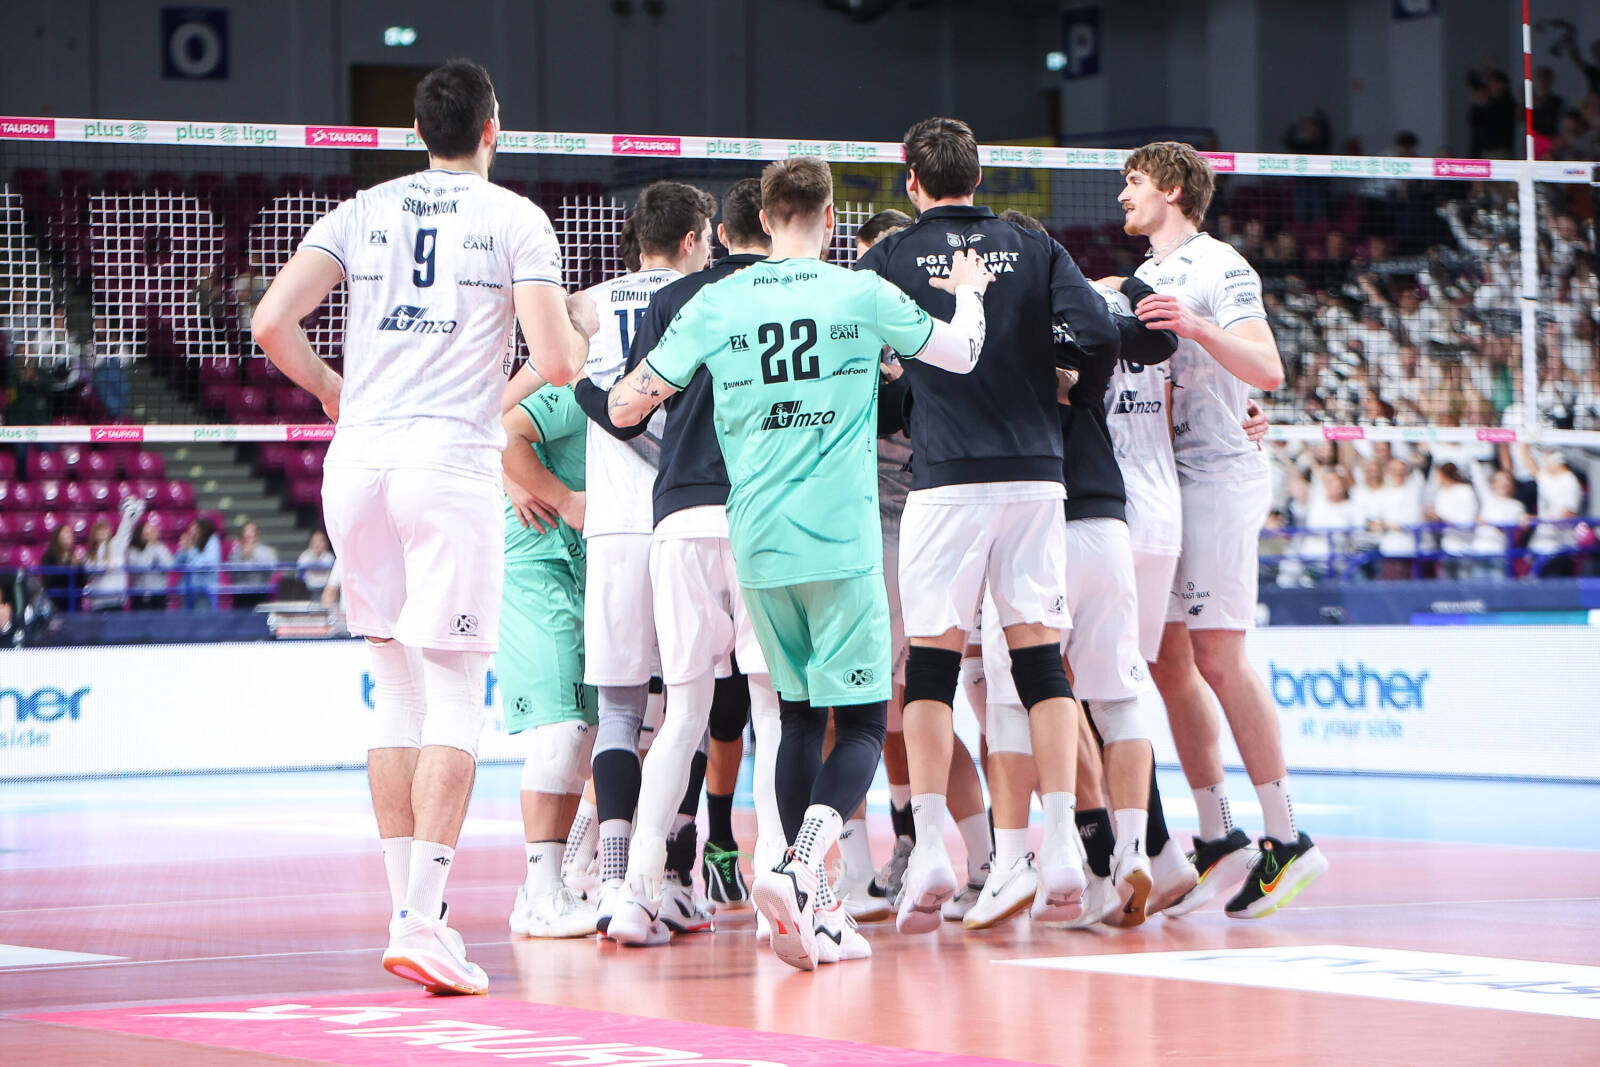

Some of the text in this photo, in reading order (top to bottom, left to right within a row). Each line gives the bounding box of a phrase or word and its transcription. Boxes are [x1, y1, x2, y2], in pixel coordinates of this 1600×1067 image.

[1, 122, 49, 135] TAURON
[84, 121, 124, 140] plus
[176, 124, 277, 144] plus liga
[328, 132, 373, 144] TAURON
[553, 134, 586, 152] liga
[634, 141, 676, 152] TAURON
[706, 140, 741, 156] plus
[787, 141, 877, 160] plus liga
[990, 147, 1023, 163] plus
[1066, 150, 1099, 165] plus
[1258, 156, 1289, 170] plus
[1330, 158, 1411, 175] plus liga
[414, 227, 437, 288] 9
[916, 254, 948, 267] PGE
[925, 262, 1015, 277] WAAWA
[753, 271, 818, 287] plus liga
[830, 324, 853, 332] BEST
[757, 318, 821, 385] 22
[793, 410, 836, 428] mza
[193, 427, 222, 441] plus
[1269, 660, 1431, 711] brother
